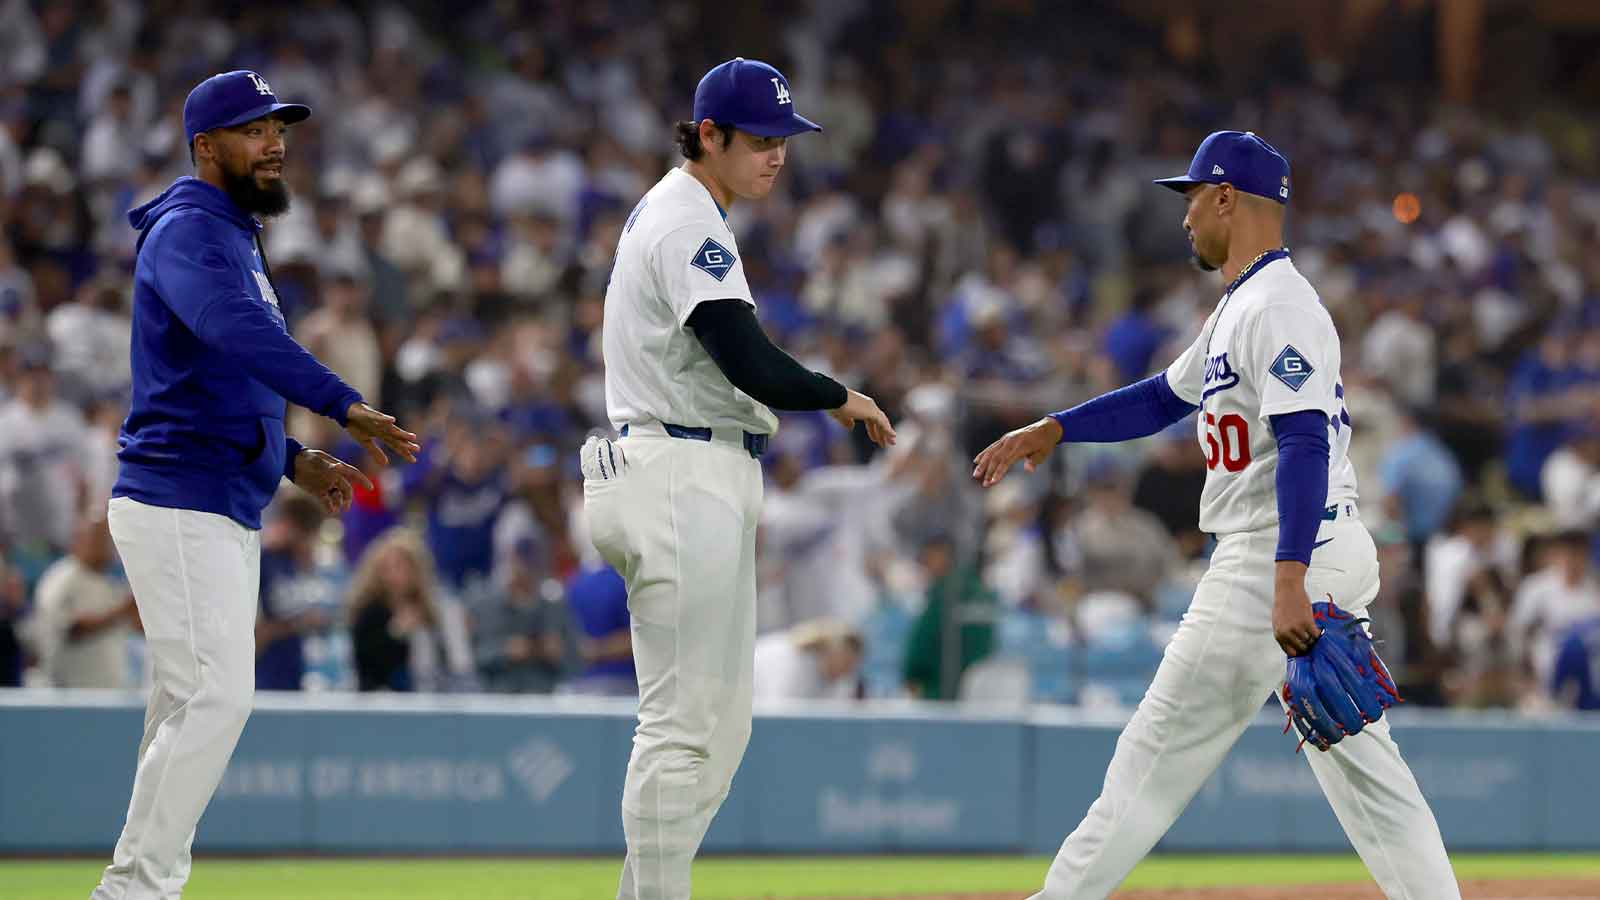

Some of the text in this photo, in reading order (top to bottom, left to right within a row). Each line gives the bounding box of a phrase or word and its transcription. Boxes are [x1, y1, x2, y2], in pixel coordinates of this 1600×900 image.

[247, 73, 273, 96] LA
[770, 77, 791, 105] LA
[704, 249, 723, 264] G
[1283, 356, 1303, 373] G
[1206, 412, 1251, 473] 50
